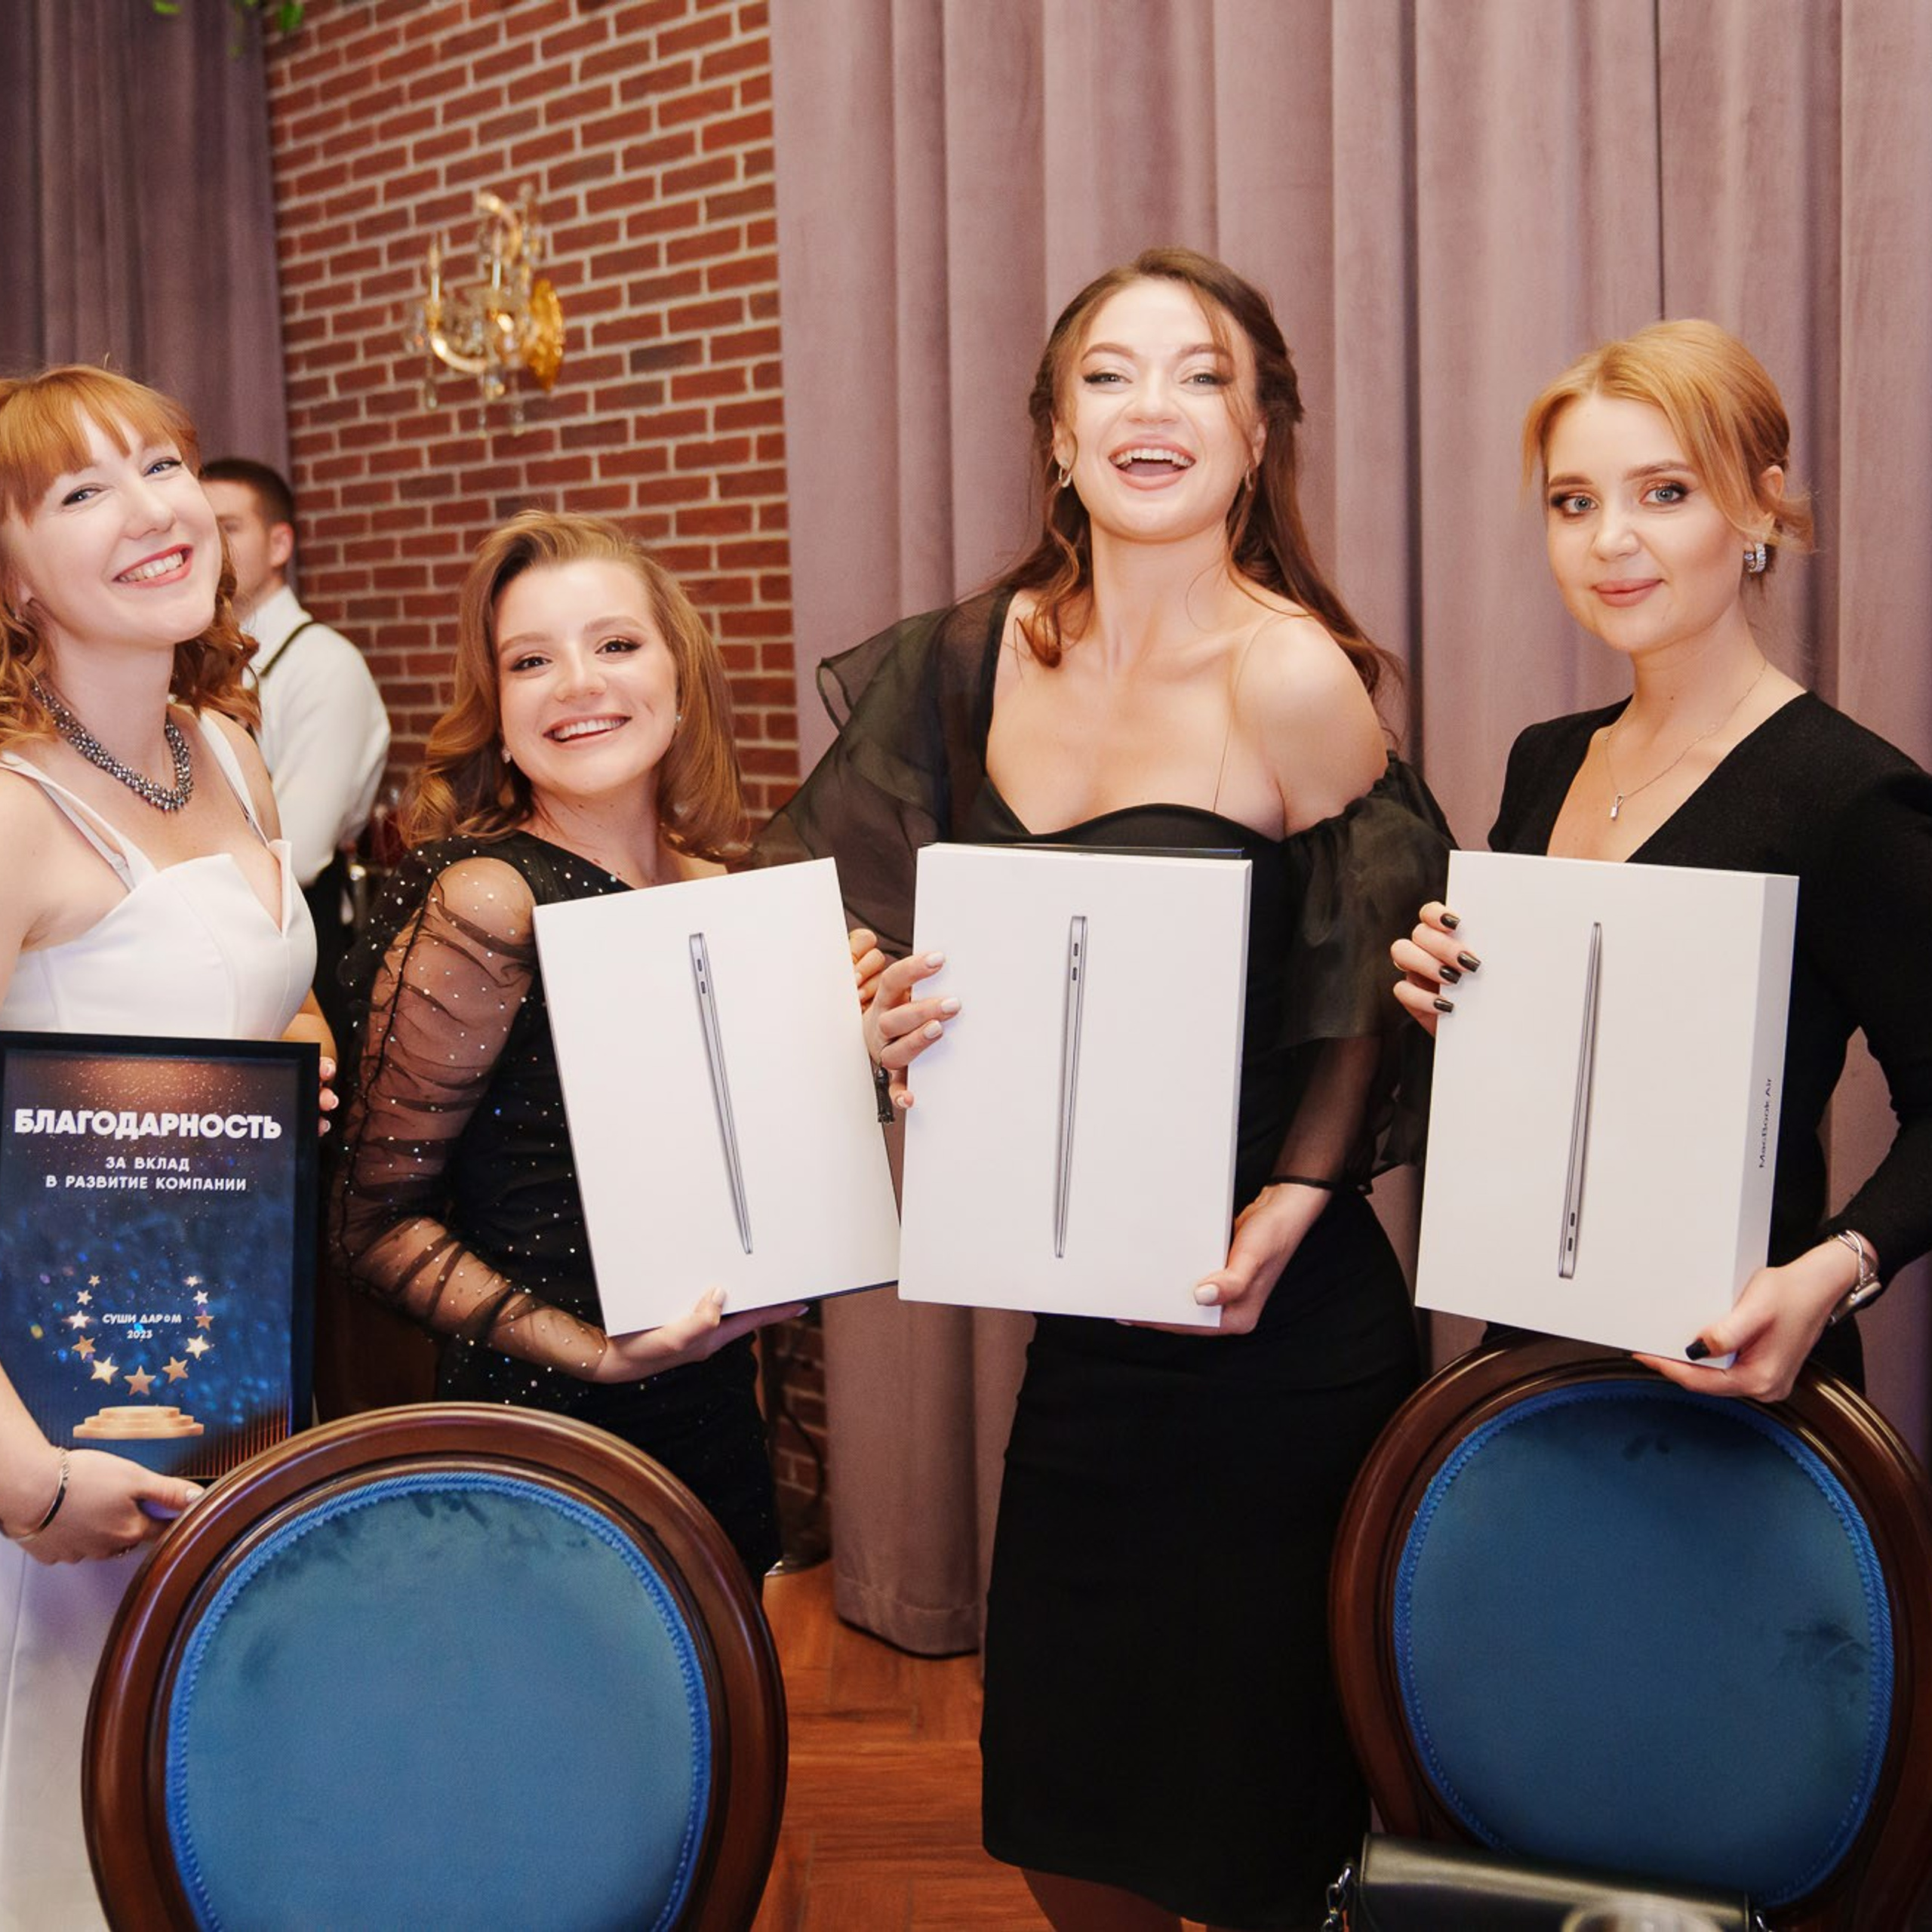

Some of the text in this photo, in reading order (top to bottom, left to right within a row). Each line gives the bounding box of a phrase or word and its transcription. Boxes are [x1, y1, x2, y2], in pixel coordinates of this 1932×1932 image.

[14, 1109, 282, 1140] БЛАГОДАРНОСТЬ
[1759, 1101, 1770, 1168] MacBook
[105, 1156, 190, 1172] ЗА ВКЛАД
[45, 1175, 247, 1191] В РАЗВИТИЕ КОМПАНИИ
[103, 1314, 182, 1324] СУШИ ДАРОМ
[127, 1331, 152, 1339] 2023
